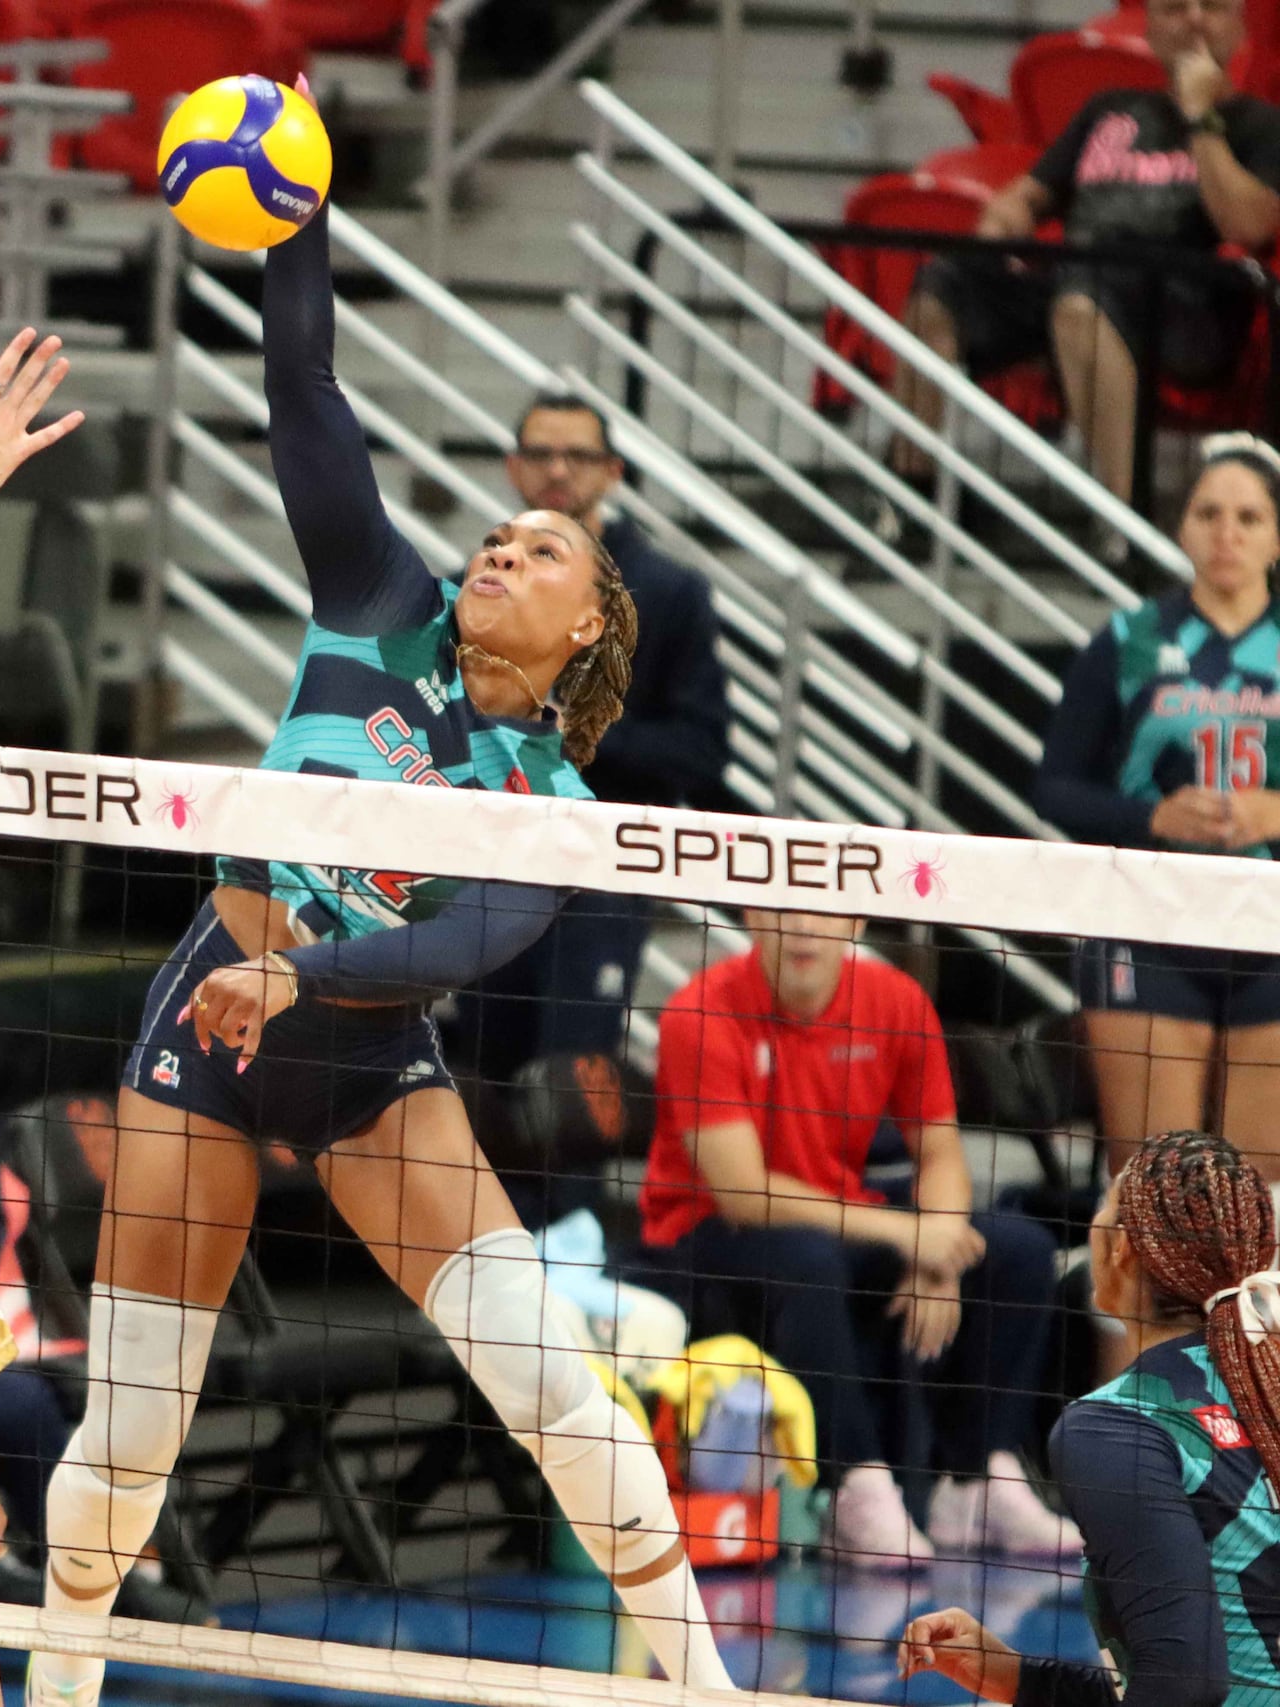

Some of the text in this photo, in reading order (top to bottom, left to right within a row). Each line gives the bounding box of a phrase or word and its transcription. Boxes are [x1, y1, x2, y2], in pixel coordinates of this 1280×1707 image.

[1194, 719, 1268, 792] 15
[615, 821, 883, 895] SPIDER
[160, 1049, 180, 1074] 21
